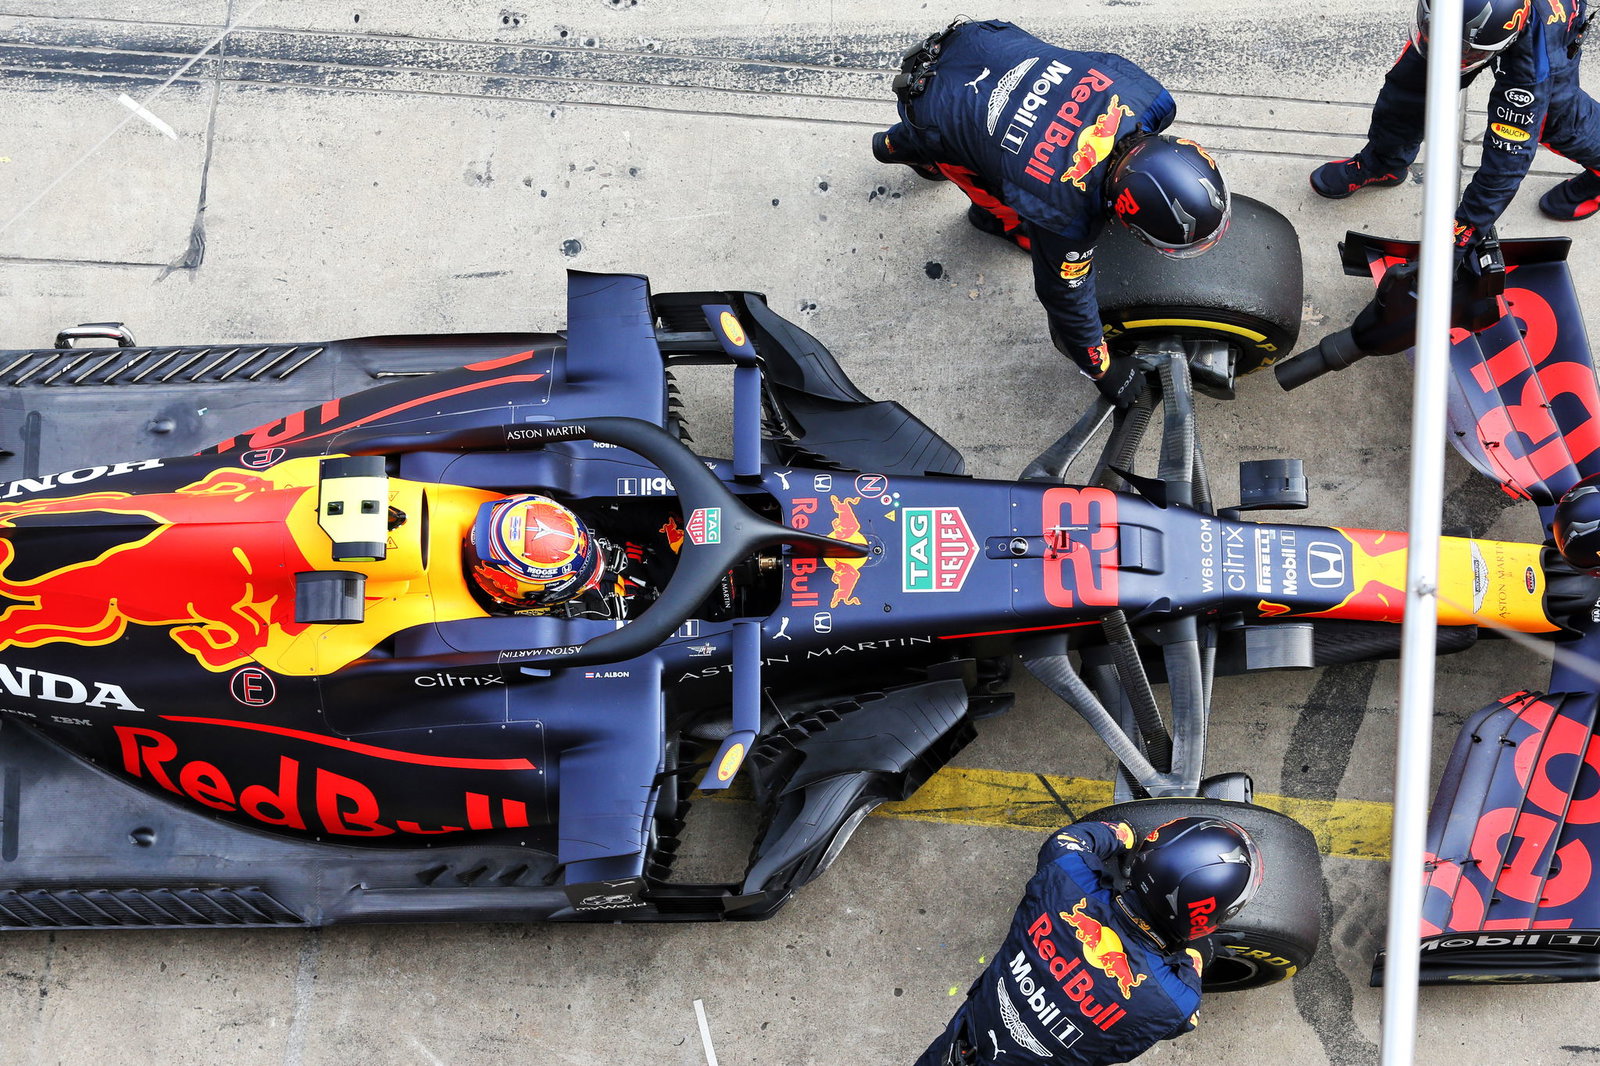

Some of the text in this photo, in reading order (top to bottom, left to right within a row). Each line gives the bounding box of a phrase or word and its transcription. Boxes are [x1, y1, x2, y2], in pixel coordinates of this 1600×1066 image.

[1014, 60, 1072, 127] Mobil
[1024, 68, 1114, 184] Red Bull
[1500, 126, 1526, 138] RAUCH
[1114, 187, 1141, 219] Re
[507, 425, 586, 440] ASTON MARTIN
[0, 457, 165, 500] HON
[689, 510, 704, 543] HEUER
[707, 509, 719, 542] TAG
[791, 497, 819, 607] Re Bull
[910, 514, 929, 586] TAG
[940, 511, 970, 587] HEUER
[1042, 487, 1118, 608] 23
[1200, 518, 1213, 593] W66.COM
[1255, 528, 1272, 594] PIRELLI
[1281, 549, 1298, 596] Mobil
[1498, 583, 1508, 619] ASTON
[501, 645, 583, 659] ASTON MARTIN
[604, 671, 630, 679] ALBON
[679, 635, 932, 684] ASTN MARTIN
[113, 725, 307, 831] Red
[1009, 950, 1062, 1027] Mobil
[1028, 912, 1127, 1031] Red Bull
